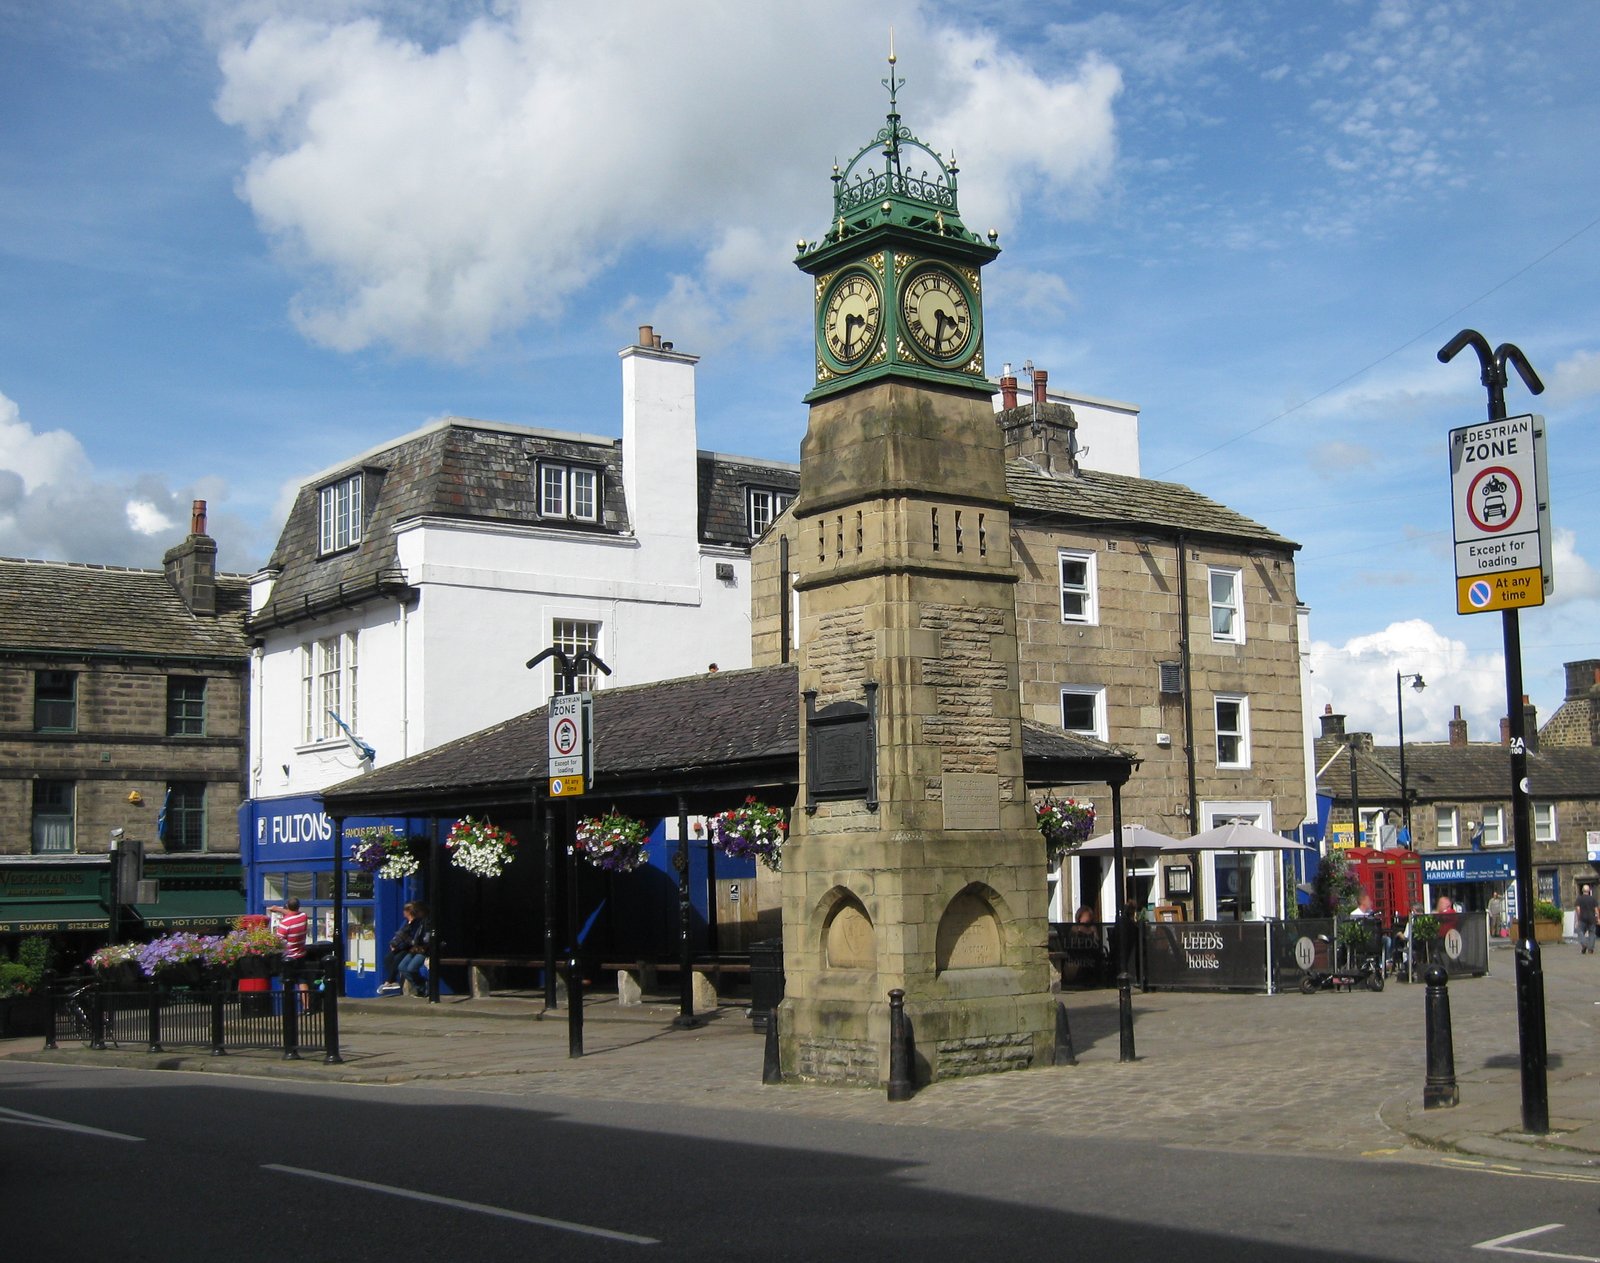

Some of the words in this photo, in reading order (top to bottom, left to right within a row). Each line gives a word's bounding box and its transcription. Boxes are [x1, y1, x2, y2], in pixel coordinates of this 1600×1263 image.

[1455, 422, 1528, 446] PEDESTRIAN
[1465, 438, 1518, 463] ZONE
[1469, 543, 1506, 559] Except
[1510, 540, 1525, 552] for
[1478, 555, 1517, 570] loading
[1495, 578, 1509, 589] At
[1512, 576, 1531, 590] any
[1502, 589, 1527, 602] time
[554, 704, 576, 716] ZONE
[1510, 737, 1525, 748] 2A
[555, 760, 570, 768] Except
[558, 767, 574, 775] loading
[272, 812, 332, 844] FULTONS
[1425, 860, 1455, 871] PAINT
[1456, 859, 1465, 870] IT
[1426, 870, 1465, 880] HARDWARE
[19, 923, 60, 931] SUMMER
[68, 921, 110, 930] SIZZLERS
[1183, 936, 1224, 950] LEEDS
[1188, 955, 1219, 969] house
